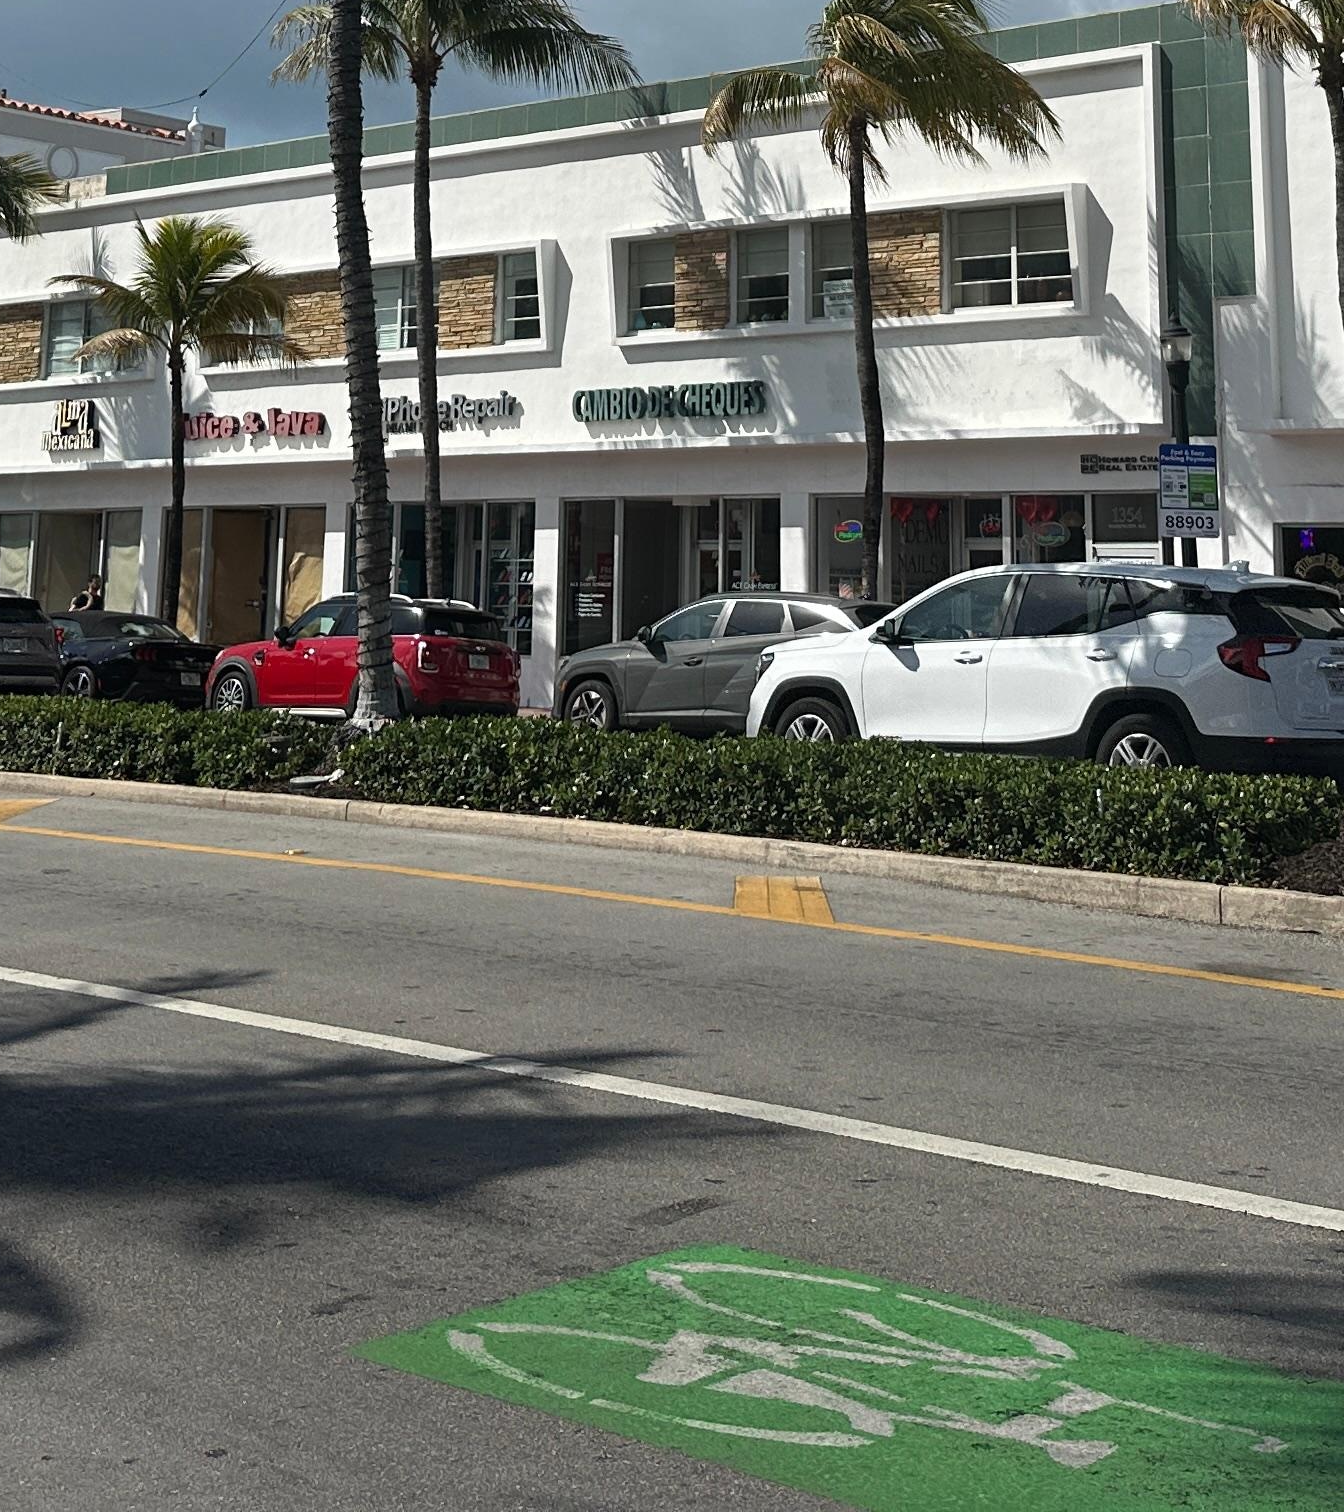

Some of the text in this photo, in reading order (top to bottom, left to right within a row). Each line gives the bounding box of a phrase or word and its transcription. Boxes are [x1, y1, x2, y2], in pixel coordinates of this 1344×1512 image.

[381, 390, 517, 423] iPhoe Repair
[572, 380, 768, 422] CAMBIO DE CHEQUES
[183, 413, 239, 439] uice
[243, 412, 265, 434] &
[386, 422, 417, 434] MIAMI
[1098, 455, 1137, 463] HOWARD
[1099, 464, 1123, 472] REAL
[1126, 464, 1159, 472] ESTATE
[1165, 515, 1214, 529] 88903
